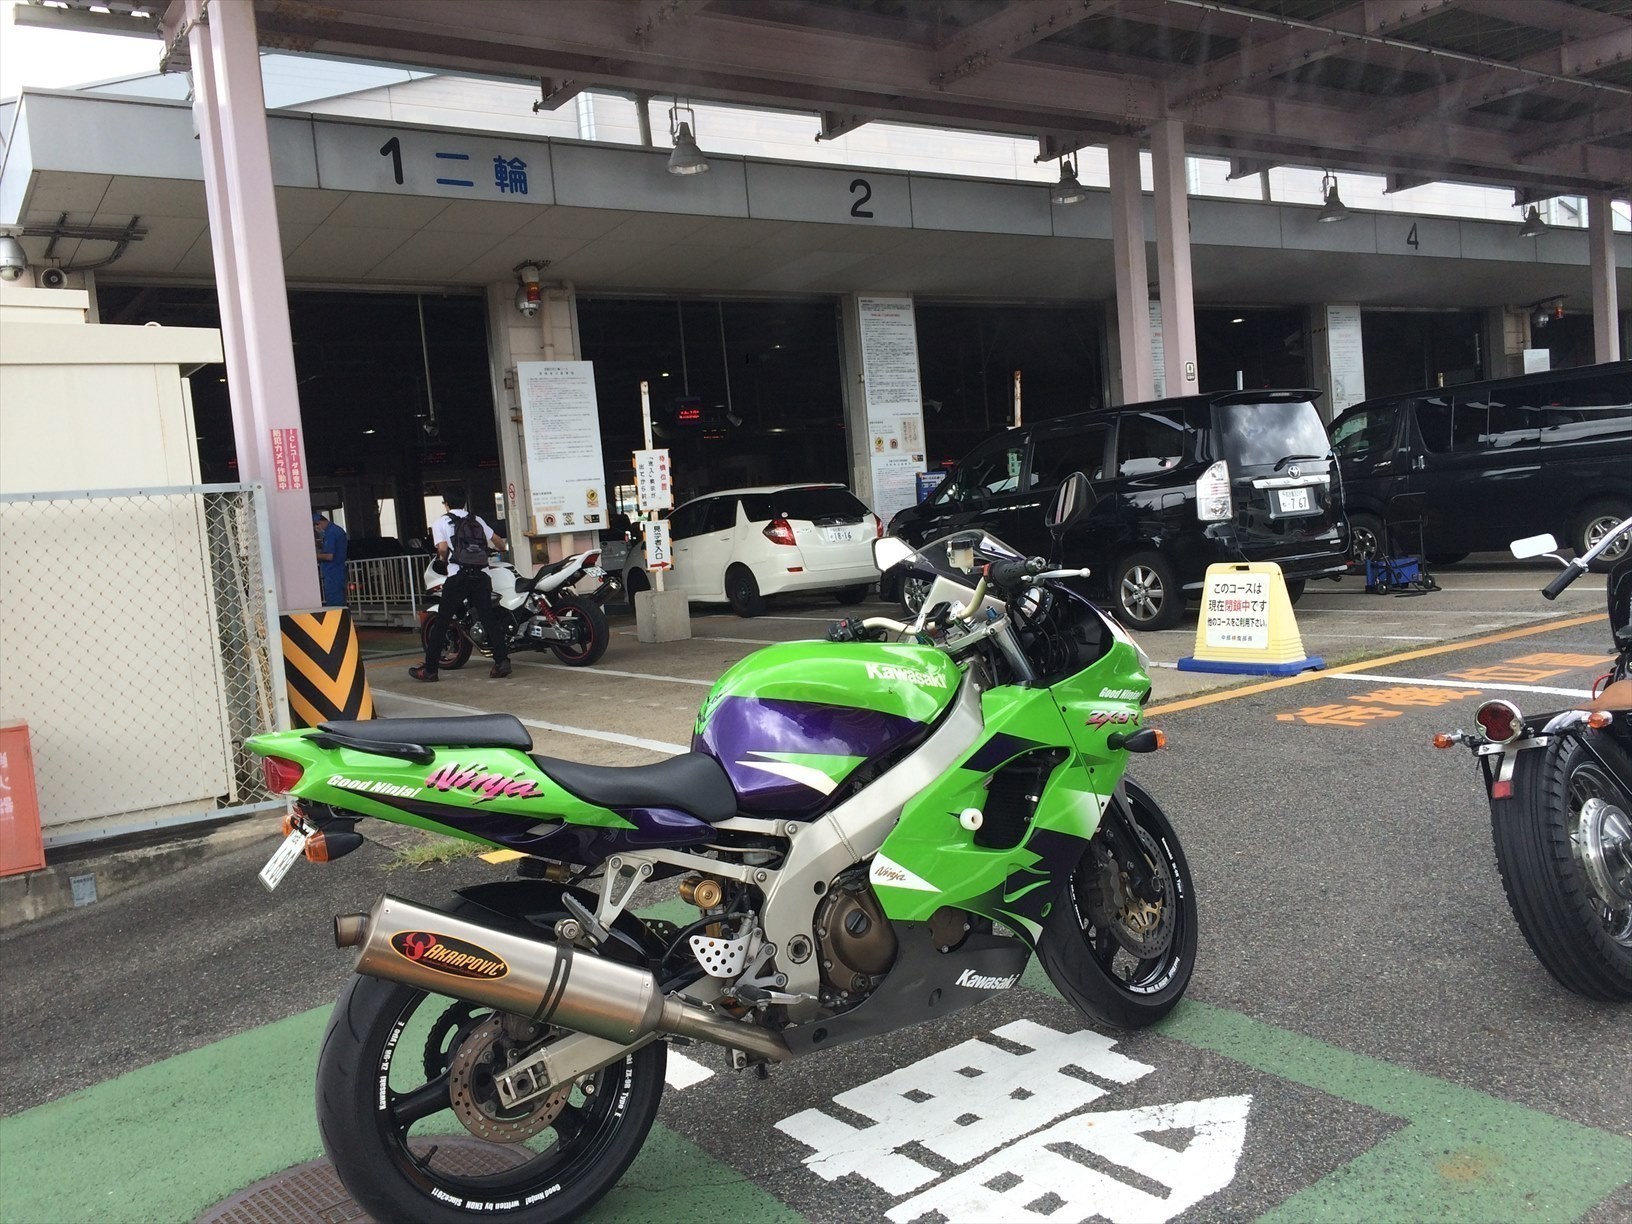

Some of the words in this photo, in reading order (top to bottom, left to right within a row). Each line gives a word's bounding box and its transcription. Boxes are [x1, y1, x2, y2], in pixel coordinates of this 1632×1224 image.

[380, 137, 404, 185] 1
[435, 152, 528, 195] 二輪
[850, 179, 873, 218] 2
[1407, 222, 1419, 250] 4
[653, 525, 663, 560] 見学者入口
[1214, 583, 1262, 594] このコースは
[1208, 599, 1267, 612] 現在閉鎖中です
[865, 663, 947, 688] Kawasaki
[1098, 687, 1122, 698] Good
[327, 774, 370, 791] Good
[370, 781, 423, 798] Ninja!
[426, 760, 545, 805] Ninja
[874, 866, 906, 881] Ninja
[954, 968, 1021, 990] Kawasaki
[379, 1075, 387, 1110] Kawasaki
[387, 1028, 401, 1047] Type
[618, 1092, 629, 1109] Type
[545, 1183, 561, 1197] Good
[484, 1202, 494, 1211] by
[495, 1200, 520, 1210] written
